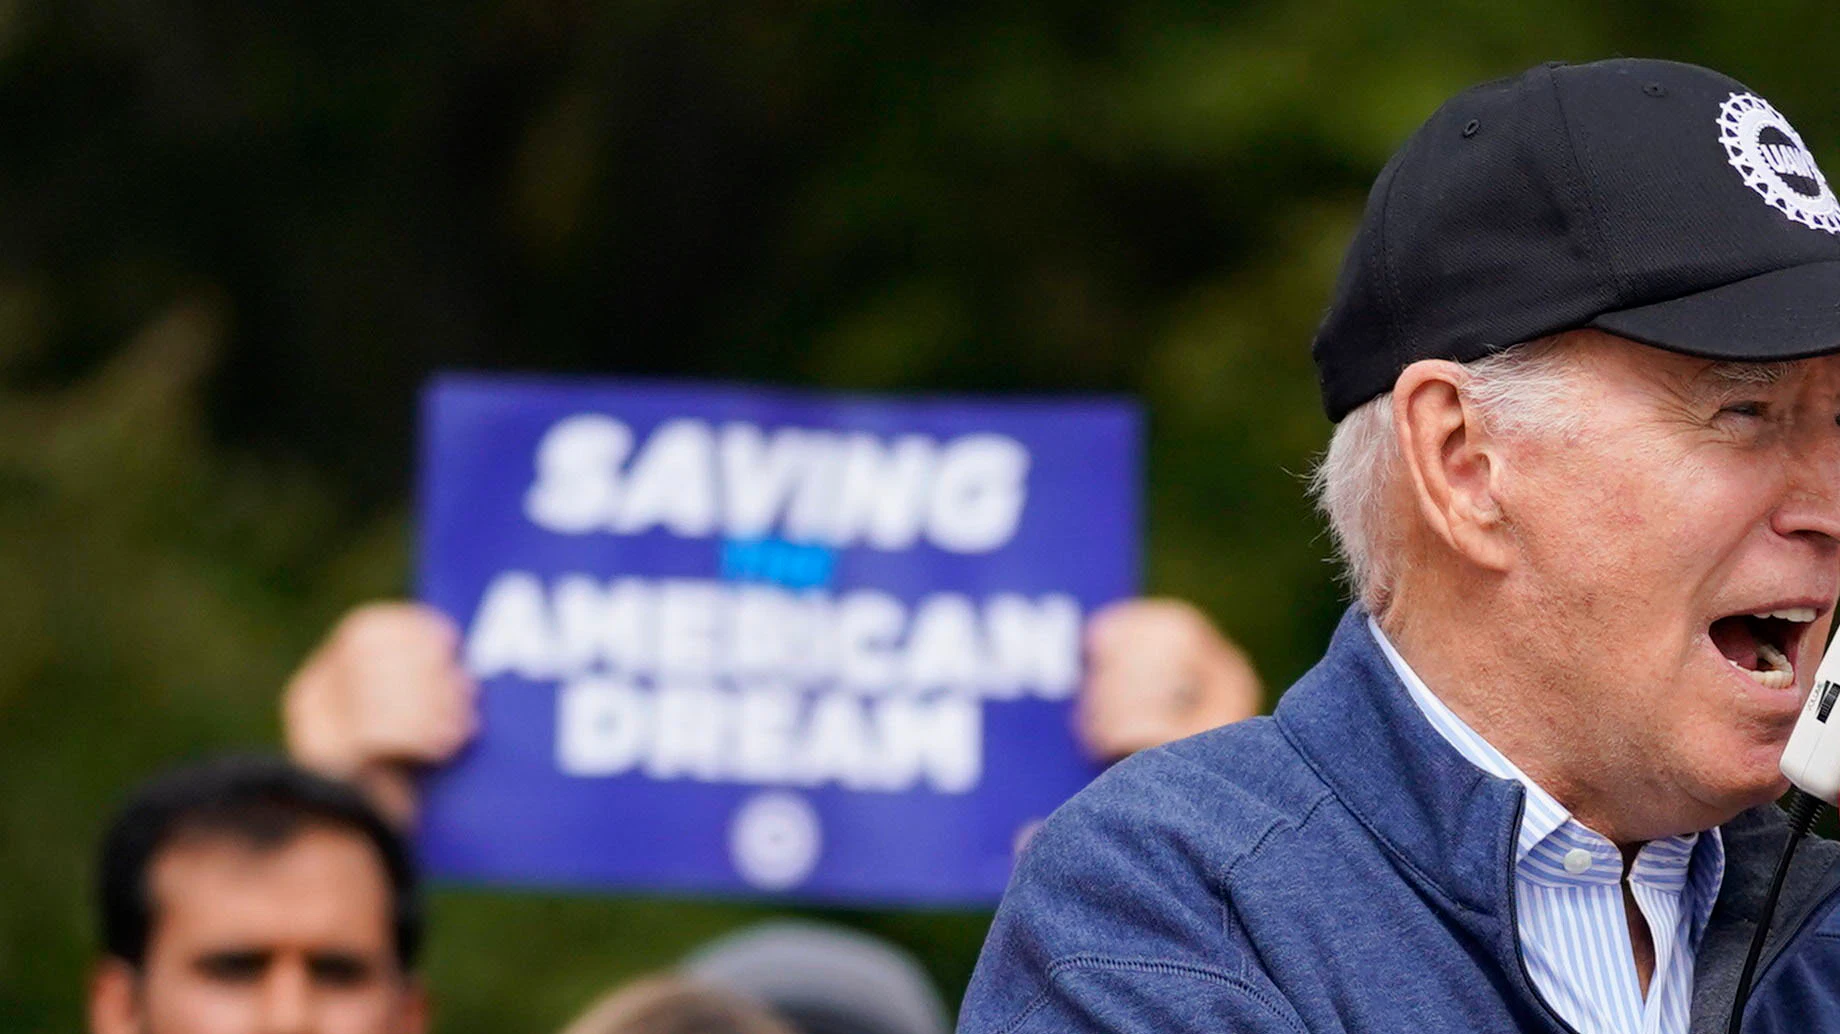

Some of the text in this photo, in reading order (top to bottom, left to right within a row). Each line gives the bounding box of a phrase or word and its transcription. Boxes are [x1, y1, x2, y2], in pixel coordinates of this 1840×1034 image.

[527, 414, 1028, 552] SAVING
[466, 571, 1081, 699] AMERICAN
[556, 679, 982, 793] DREAM
